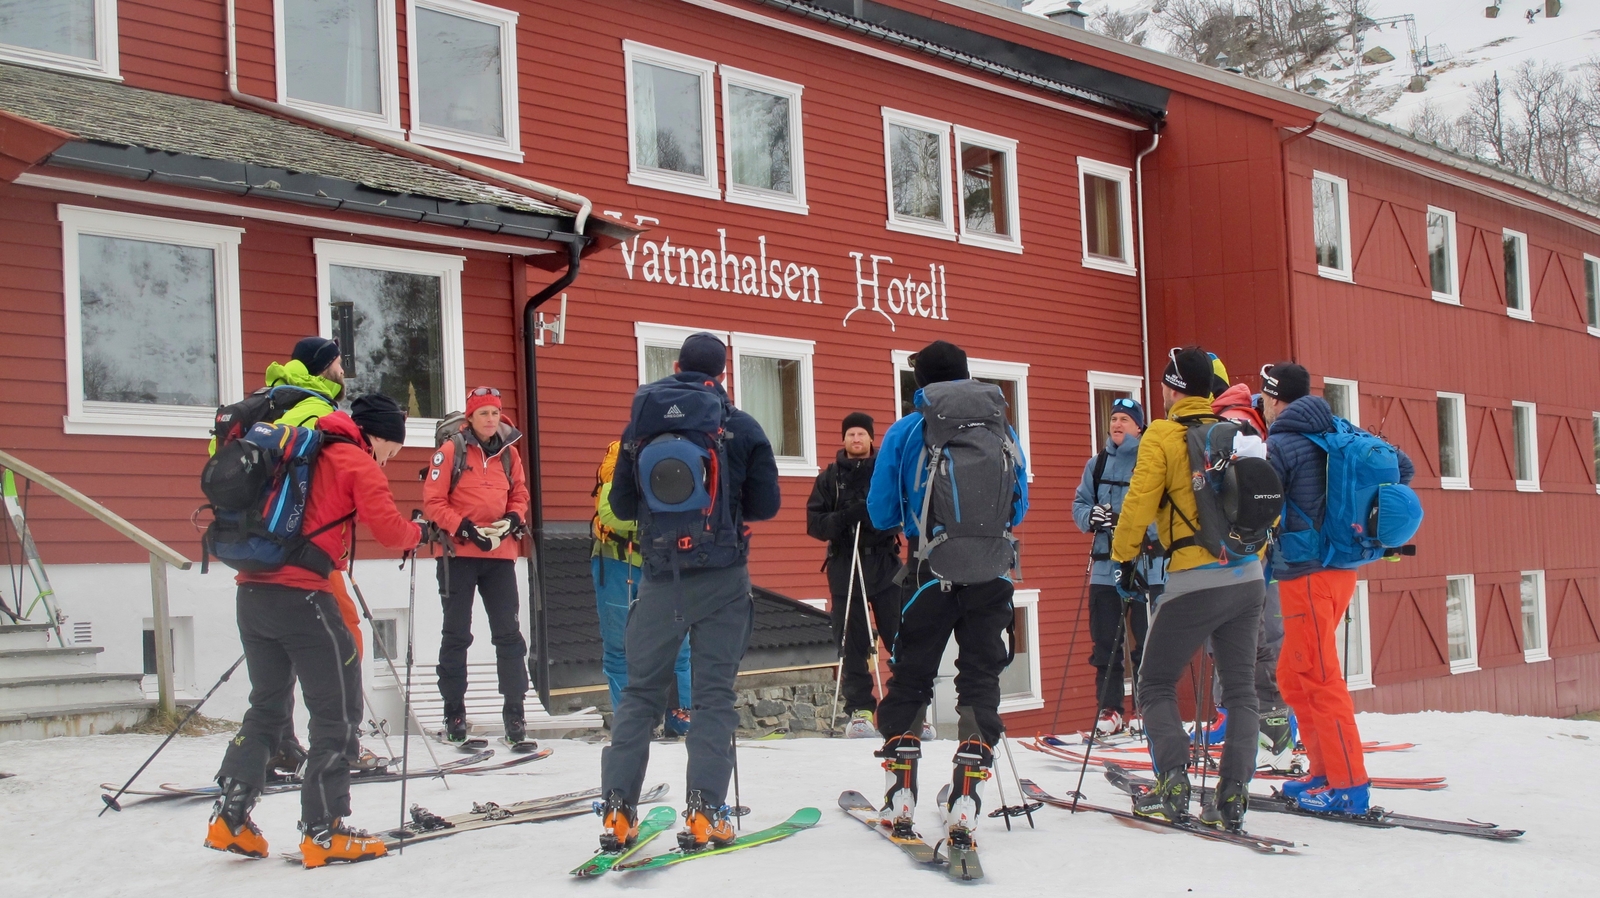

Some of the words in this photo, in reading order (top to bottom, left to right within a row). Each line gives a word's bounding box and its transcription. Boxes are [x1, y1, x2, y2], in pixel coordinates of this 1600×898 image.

[603, 210, 823, 304] Vatnahalsen
[843, 251, 949, 332] Hotell
[1140, 803, 1165, 812] SCARPA
